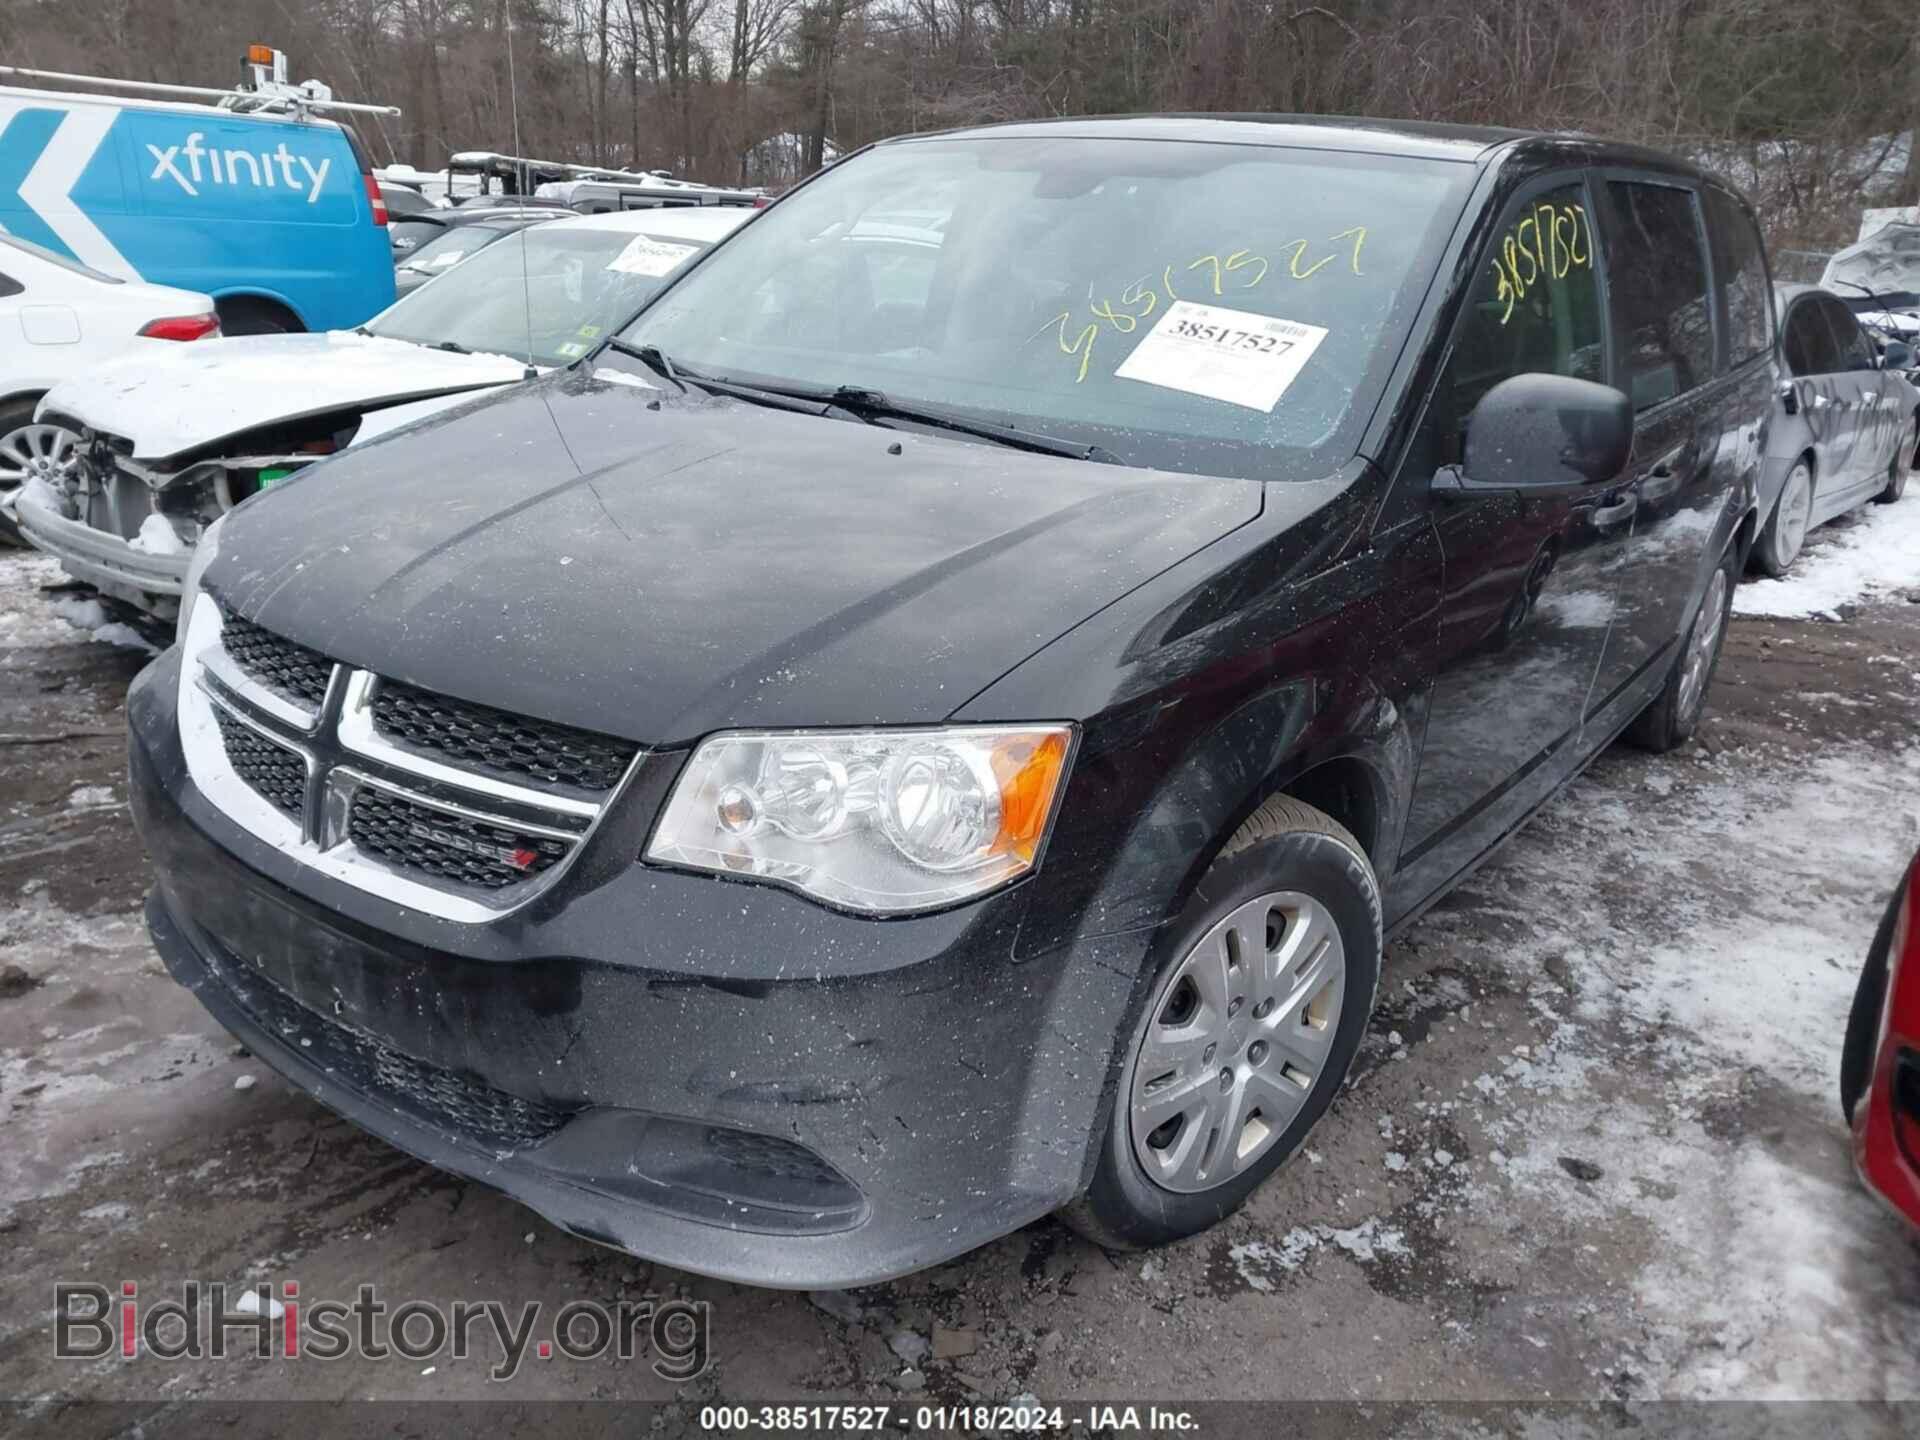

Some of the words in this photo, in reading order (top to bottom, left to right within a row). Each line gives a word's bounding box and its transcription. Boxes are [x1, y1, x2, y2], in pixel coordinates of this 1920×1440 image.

[145, 132, 331, 203] xfinity
[1491, 202, 1593, 326] 38517527
[1026, 227, 1368, 383] 38517527
[1168, 319, 1296, 356] 38517527
[409, 822, 523, 870] DODGE
